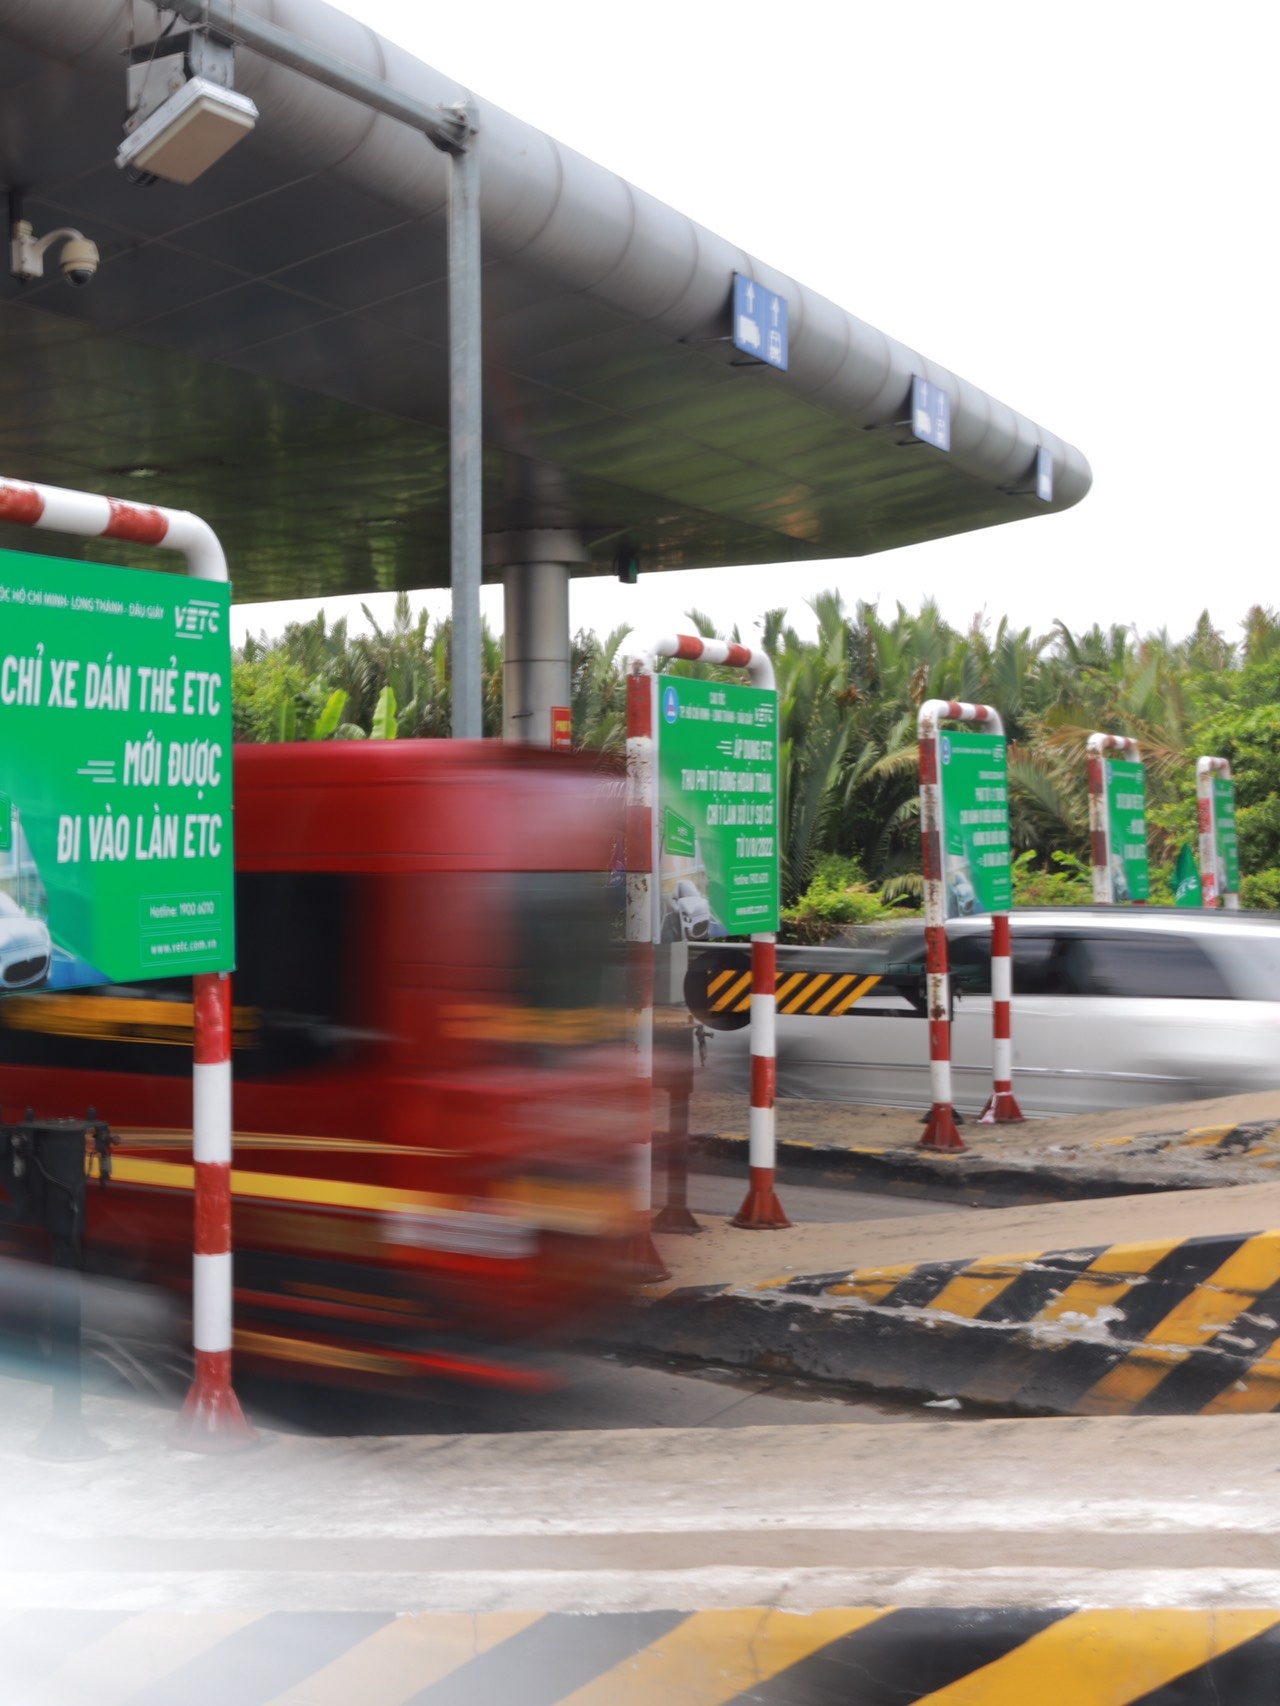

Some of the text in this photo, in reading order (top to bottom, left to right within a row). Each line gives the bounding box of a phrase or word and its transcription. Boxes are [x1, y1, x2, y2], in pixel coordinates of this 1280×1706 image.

[27, 588, 42, 605] CHÍ
[71, 595, 94, 612] LONG
[174, 604, 220, 633] VETC
[1, 642, 222, 717] CHỈ XE DÁN THẺ ETC
[123, 729, 222, 800] MỚI ĐƯỢC
[56, 803, 222, 863] ĐI VÀO LÀN ETC
[149, 904, 178, 918] Hotline:
[179, 902, 196, 916] 1900
[150, 939, 217, 955] www.vetc.com.vn
